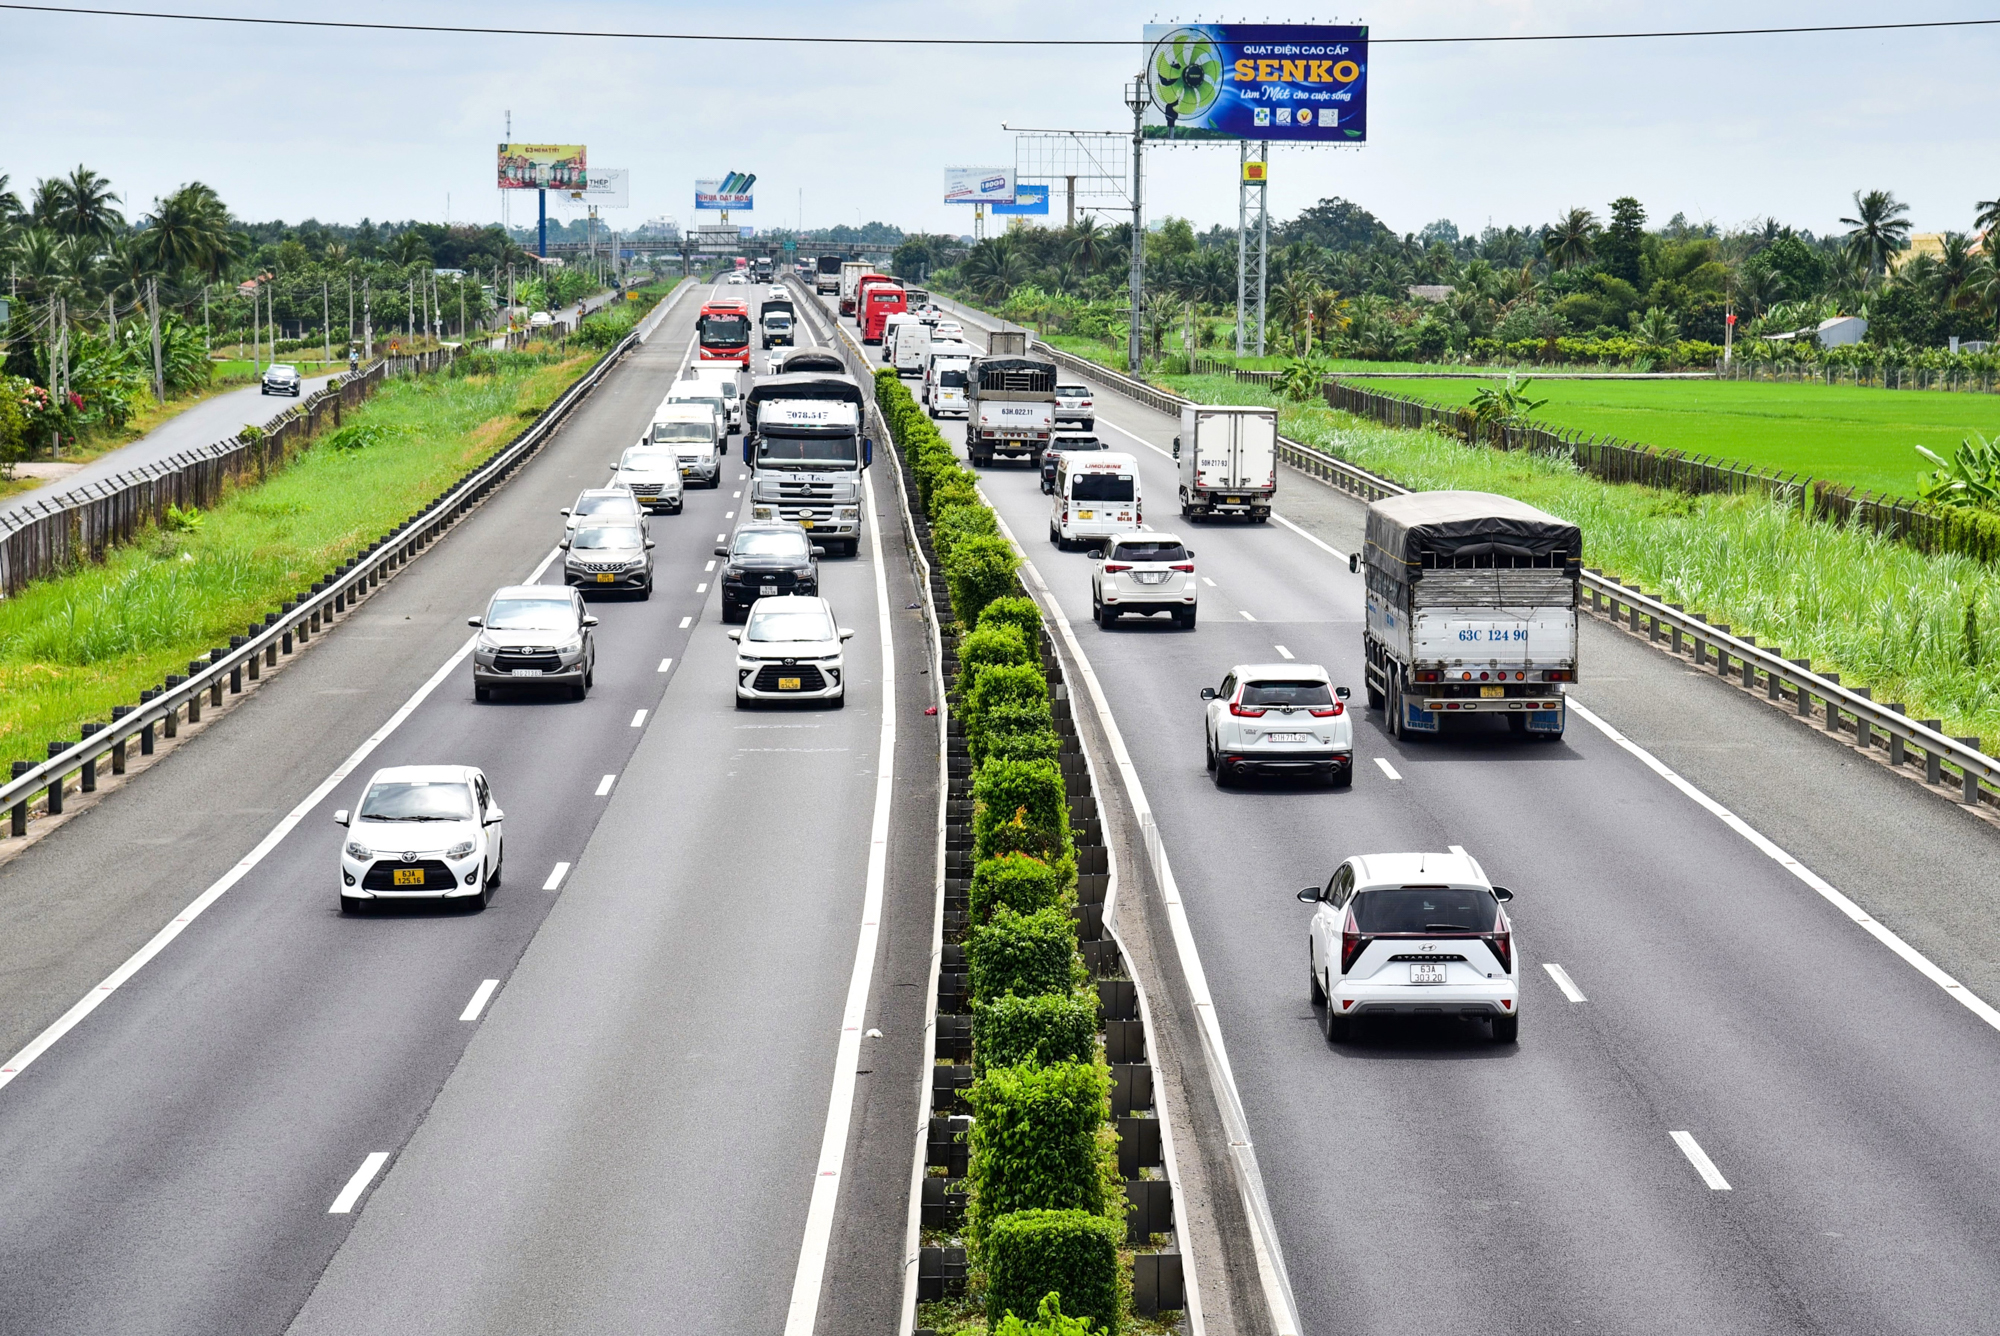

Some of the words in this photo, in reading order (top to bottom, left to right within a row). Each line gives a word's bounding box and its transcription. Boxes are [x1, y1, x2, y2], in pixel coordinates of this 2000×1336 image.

[1243, 45, 1273, 56] QUẠT
[1274, 44, 1300, 56] ĐIỆN
[1301, 46, 1325, 55] CAO
[1326, 44, 1349, 55] CẤP
[1234, 59, 1360, 83] SENKO
[1240, 89, 1260, 99] Làm
[1261, 85, 1291, 102] Mát
[1293, 90, 1309, 100] cho
[1310, 91, 1331, 102] cuộc
[1331, 89, 1352, 102] sống
[1459, 630, 1482, 641] 63C
[1488, 630, 1509, 641] 124
[1513, 630, 1528, 641] 90
[1407, 721, 1436, 729] TRUCK
[1420, 965, 1436, 973] 63A
[1414, 974, 1442, 982] 303.20
